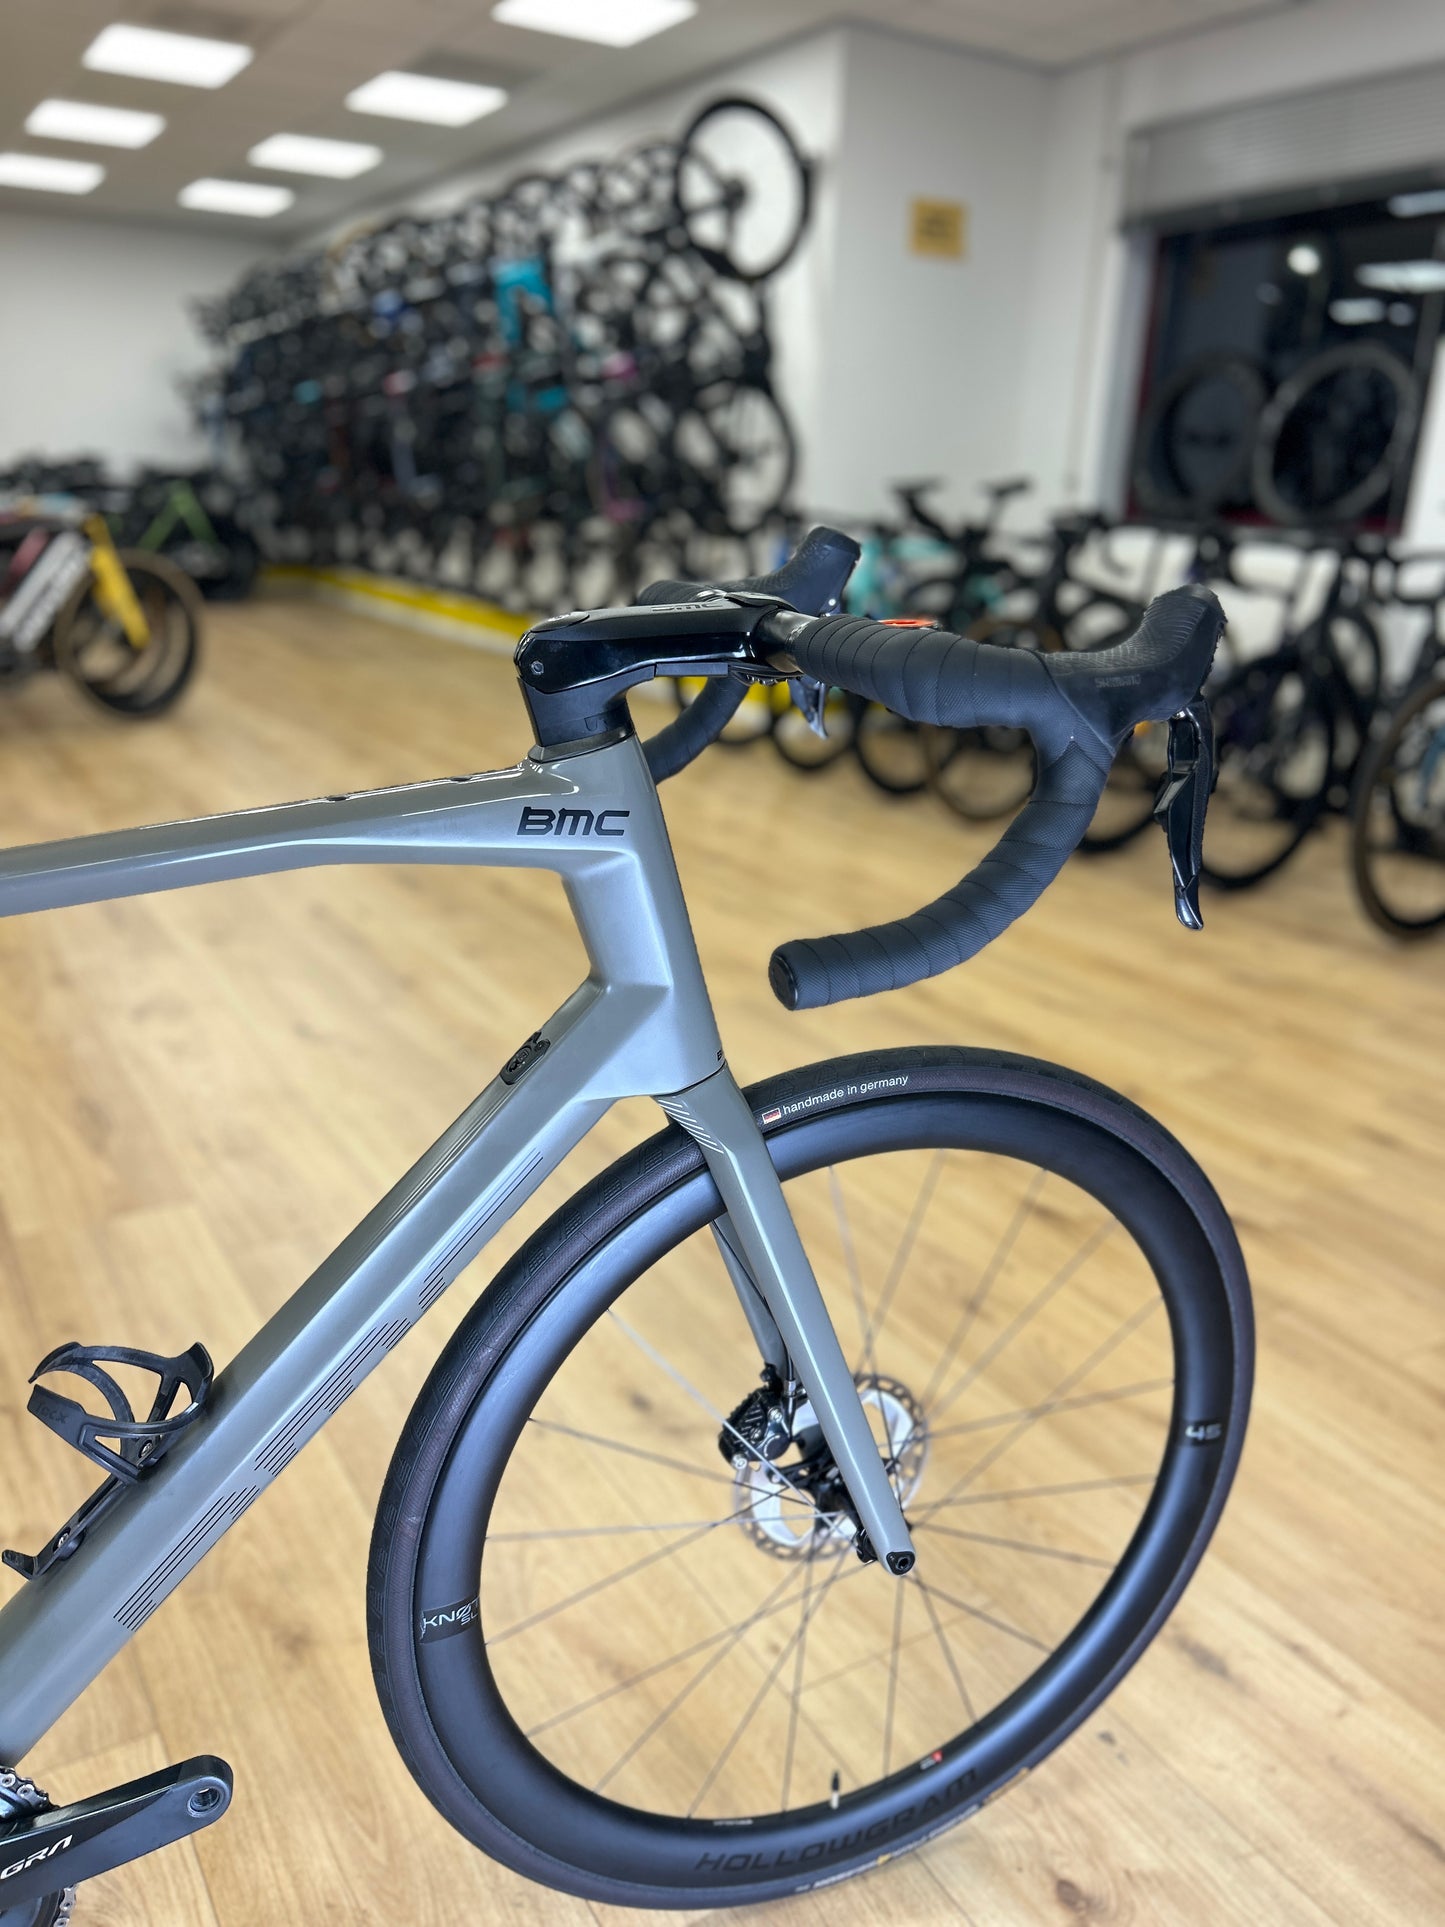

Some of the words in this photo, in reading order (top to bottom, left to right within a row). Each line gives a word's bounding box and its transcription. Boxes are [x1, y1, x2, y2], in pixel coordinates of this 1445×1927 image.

[517, 807, 630, 836] BMC
[783, 1087, 844, 1115] handmade
[847, 1085, 857, 1095] in
[861, 1075, 909, 1093] germany
[1185, 1424, 1221, 1440] 45
[694, 1767, 977, 1872] HOLLOWGRAM
